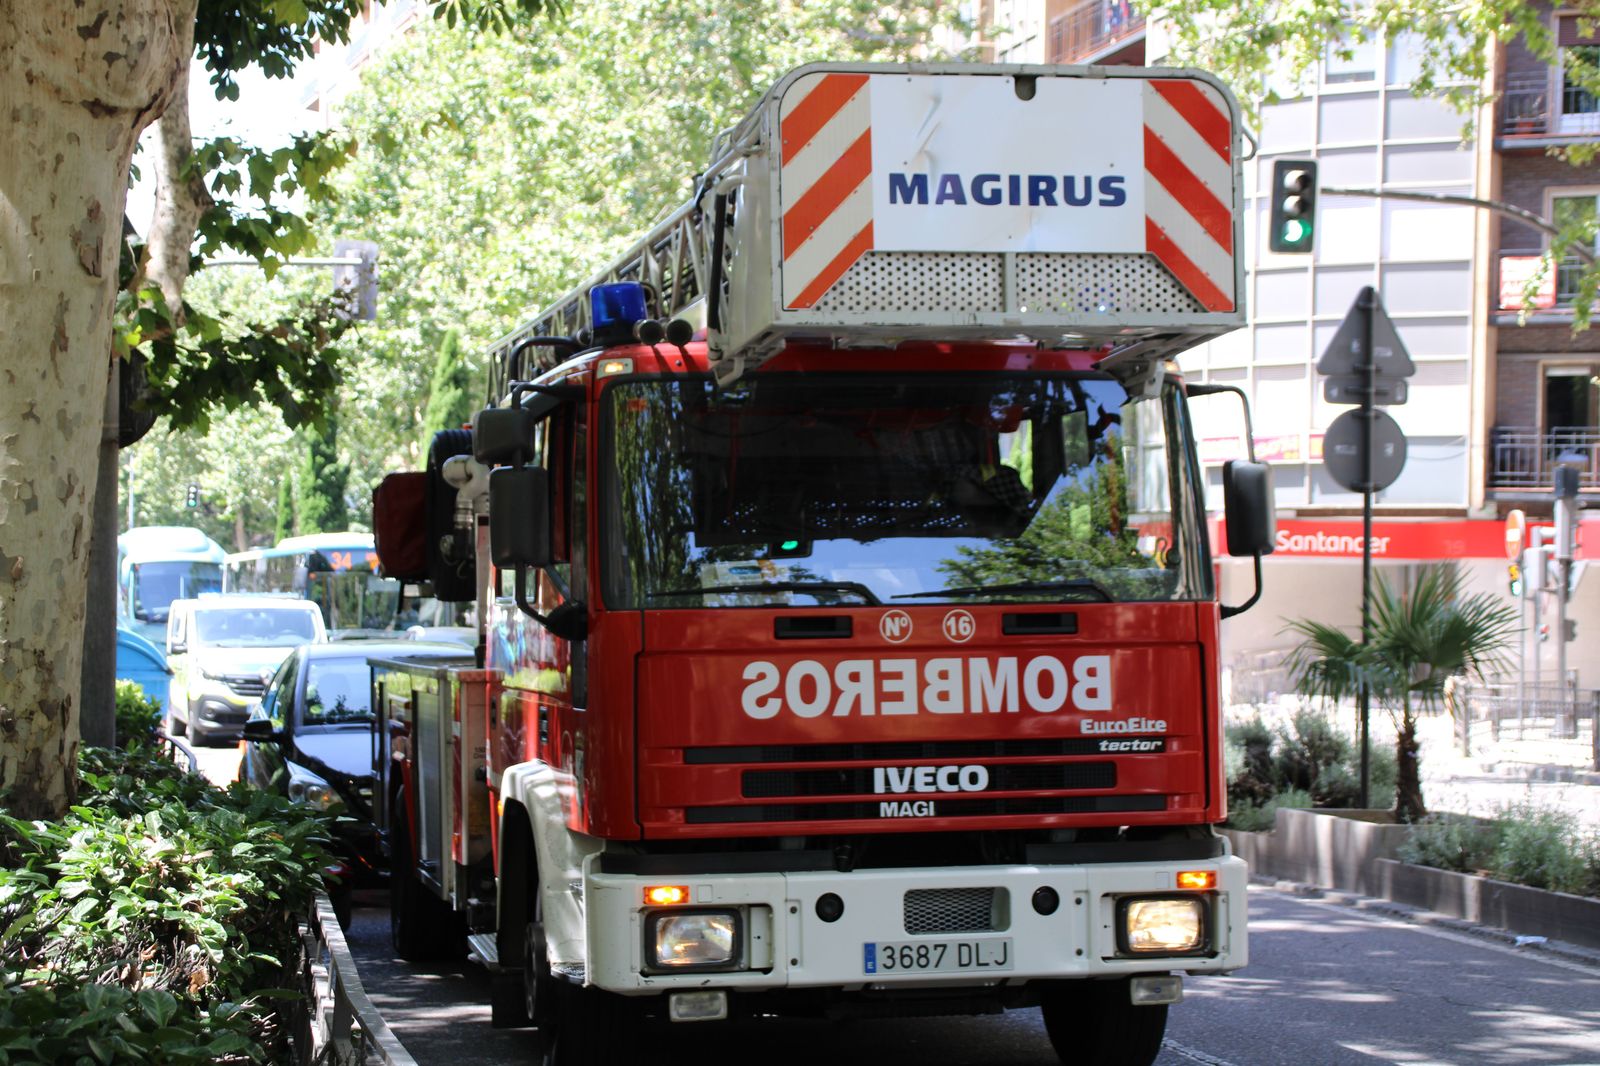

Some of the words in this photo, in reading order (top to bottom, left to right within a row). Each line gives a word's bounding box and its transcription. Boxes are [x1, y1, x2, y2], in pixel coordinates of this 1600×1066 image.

[889, 173, 1127, 207] MAGIRUS
[331, 551, 352, 570] 34
[946, 616, 971, 636] 16
[1099, 740, 1162, 751] tector
[874, 765, 989, 793] IVECO
[880, 801, 935, 817] MAGI
[882, 944, 947, 969] 3687
[958, 942, 1007, 967] DLJ
